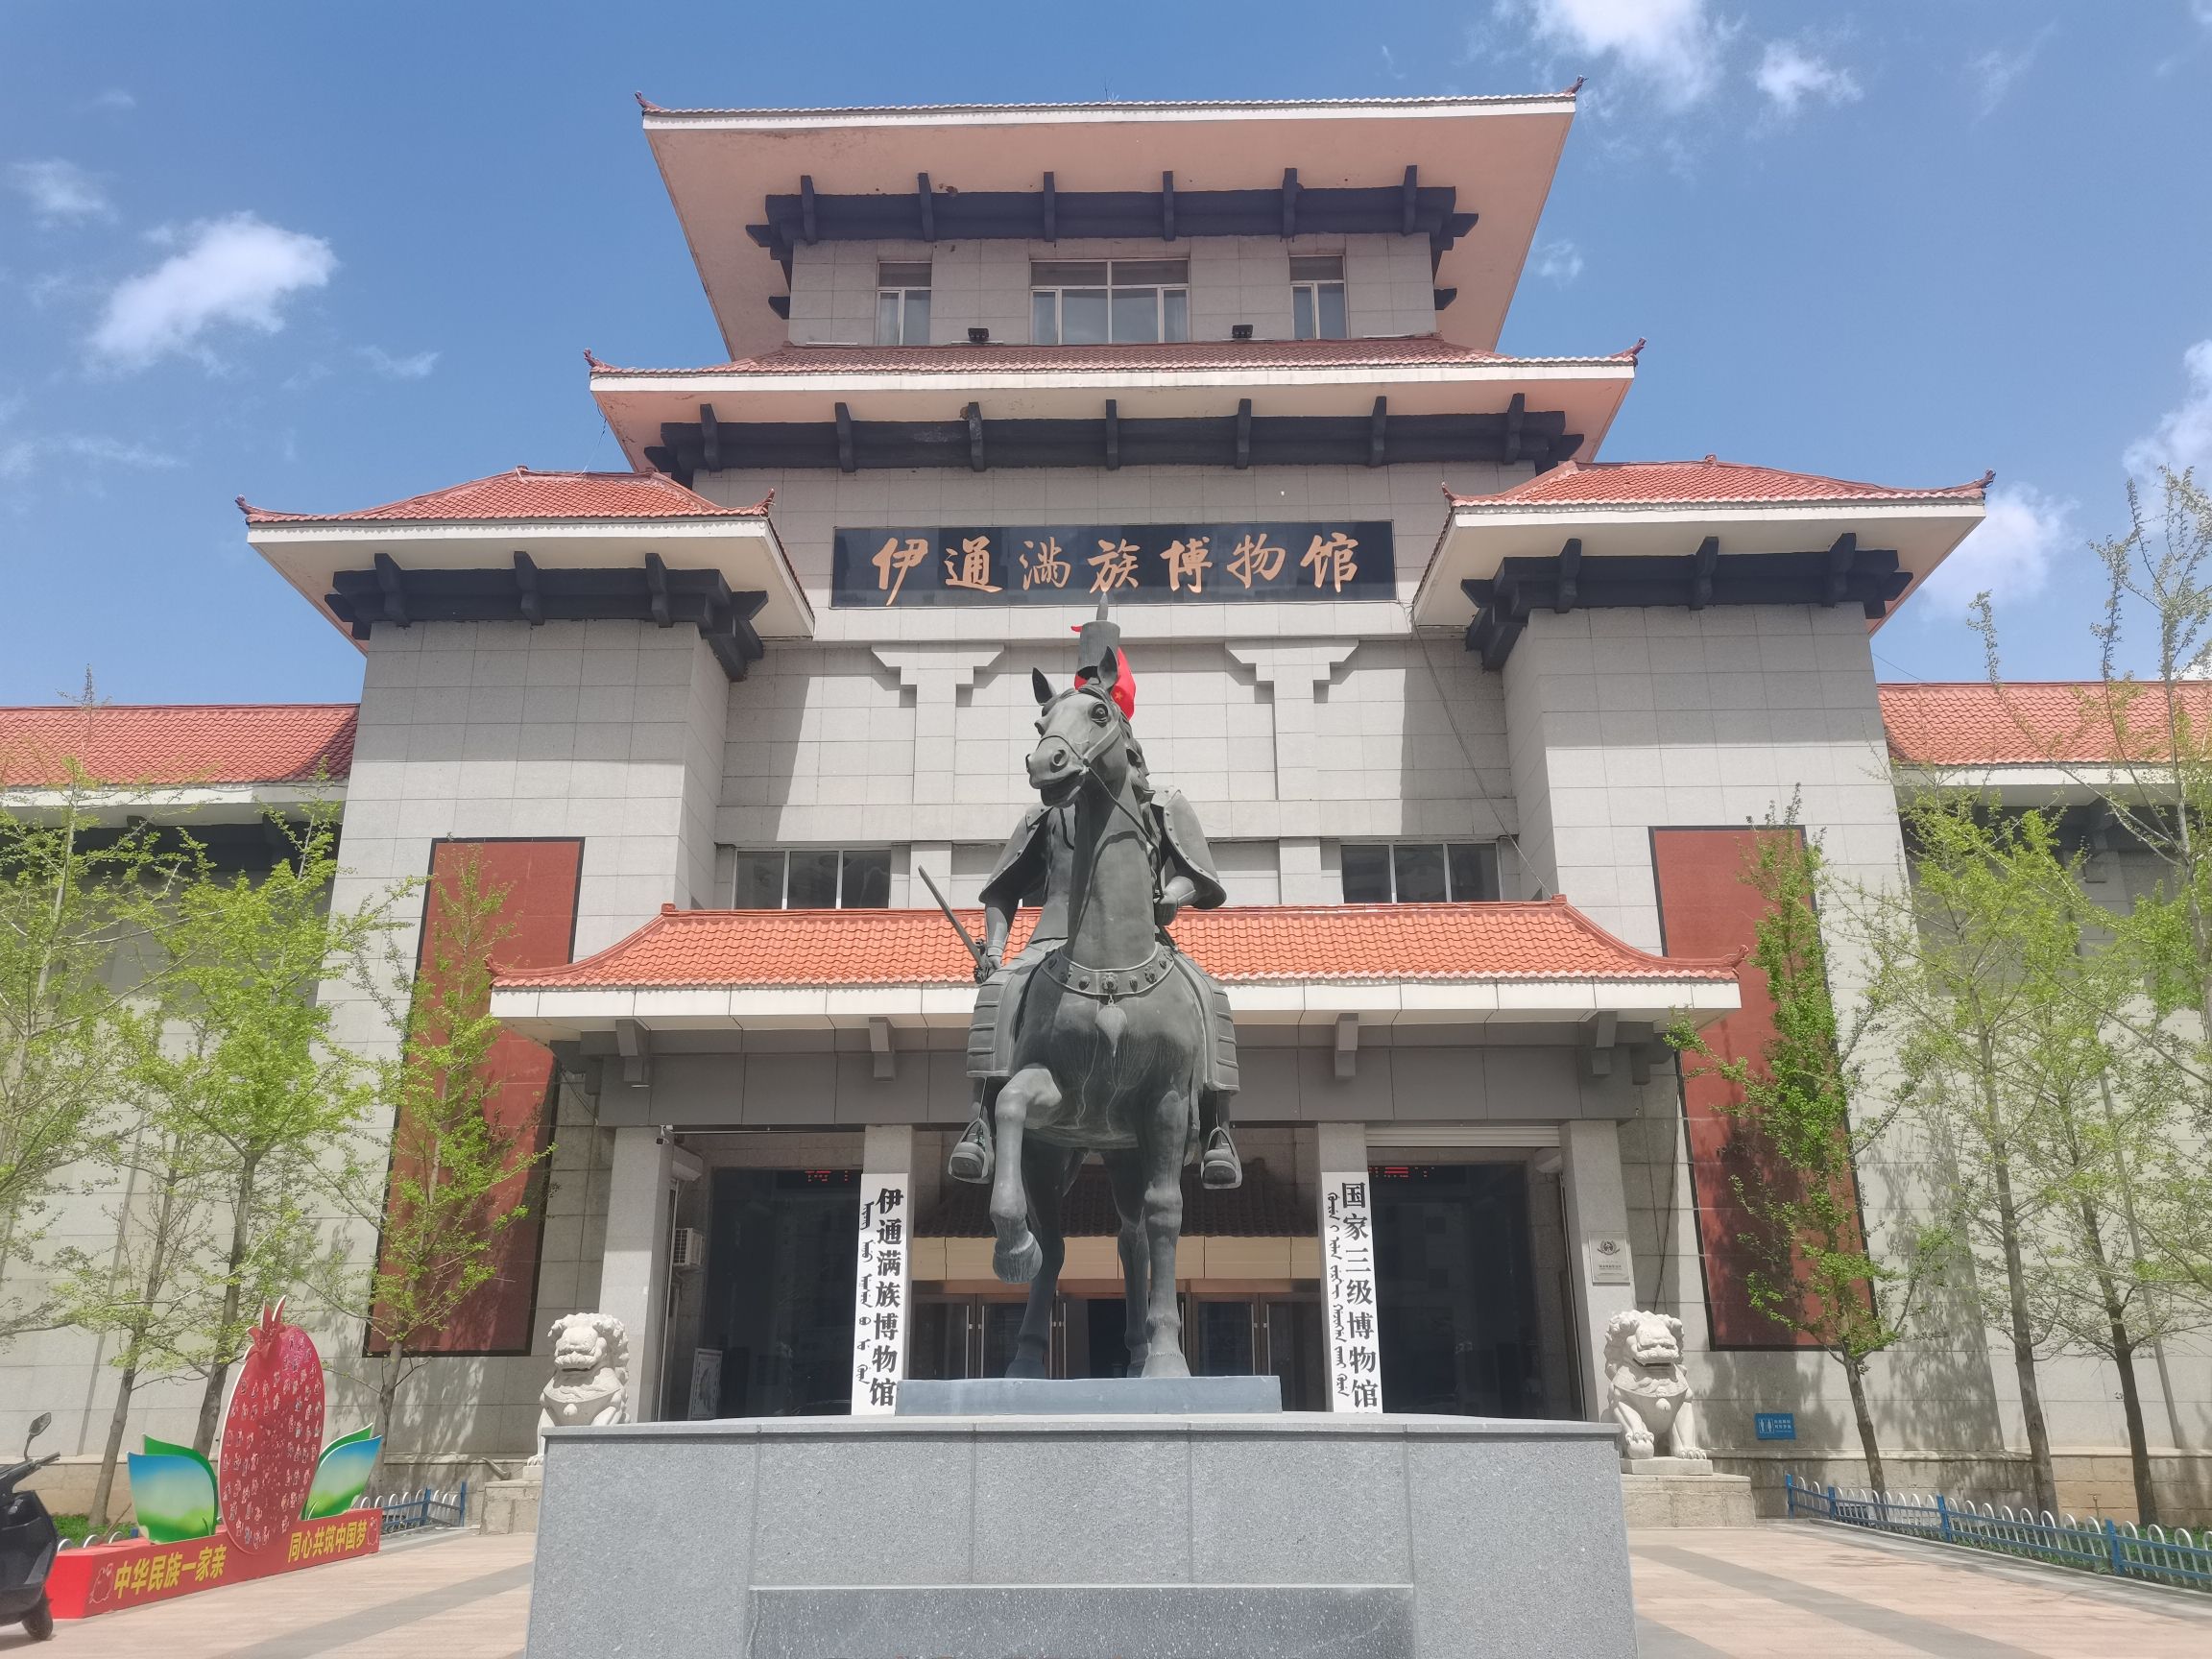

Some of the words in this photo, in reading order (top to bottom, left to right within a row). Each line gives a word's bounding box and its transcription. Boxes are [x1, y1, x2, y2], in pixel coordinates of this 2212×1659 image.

[871, 532, 1358, 606] 伊通满族博物馆
[869, 1188, 904, 1407] 伊通满族博物馆
[1342, 1182, 1378, 1407] 国家三级博物馆
[114, 1544, 228, 1599] 中华民族一家亲
[288, 1519, 368, 1563] 同心共筑中国梦
